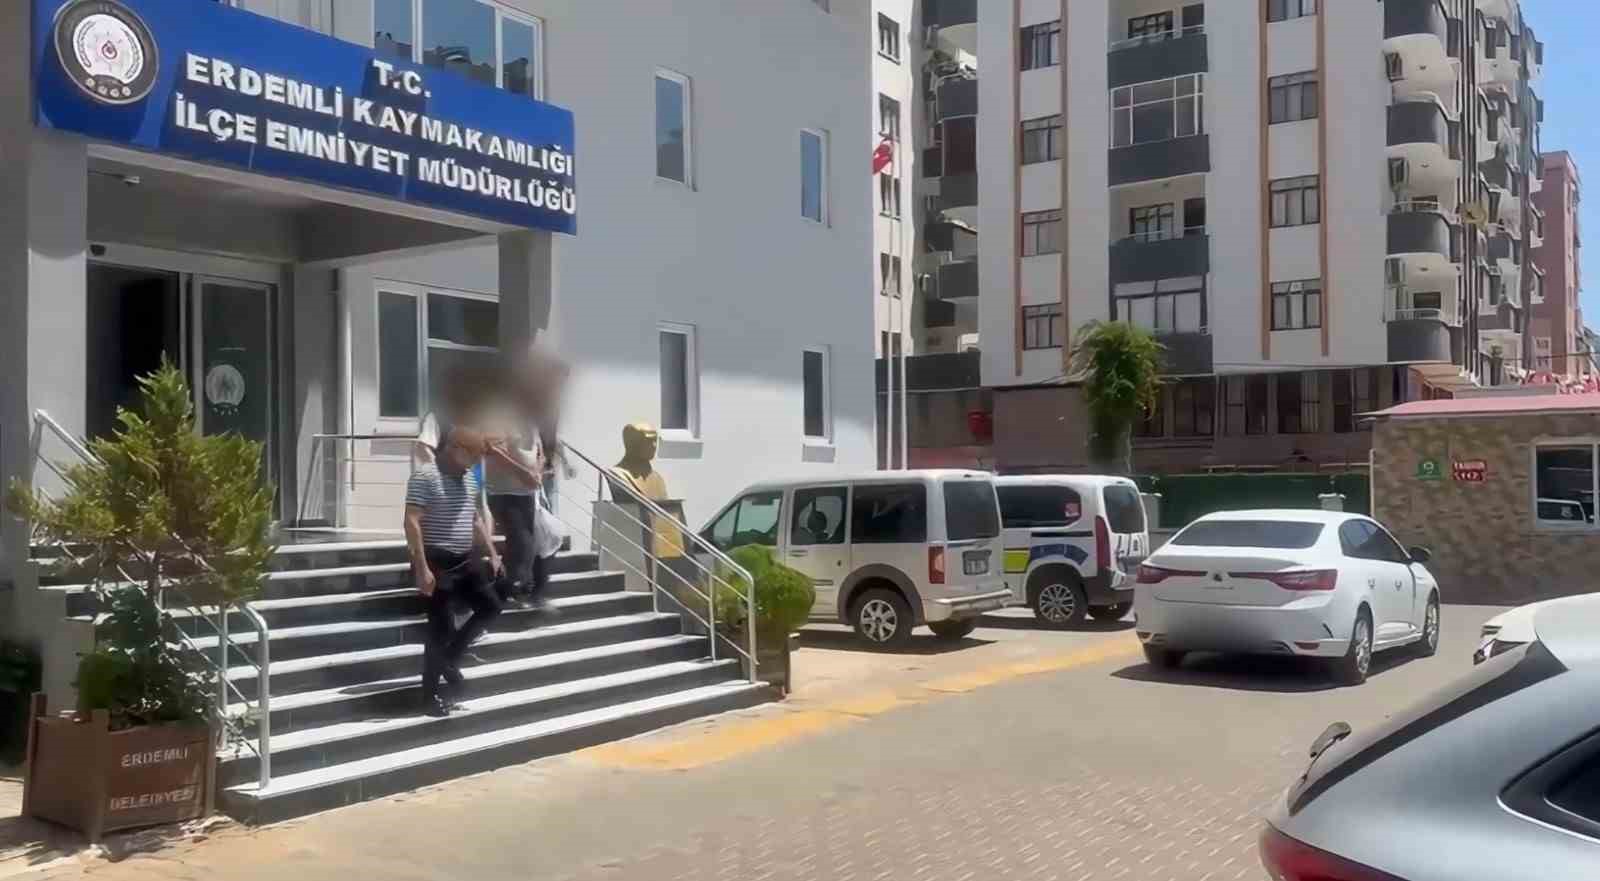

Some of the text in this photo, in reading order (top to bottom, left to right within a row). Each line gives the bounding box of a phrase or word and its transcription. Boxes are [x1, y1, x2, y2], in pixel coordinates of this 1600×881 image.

[186, 53, 573, 176] ERDEMLİ KAYMAKAMLIĞI
[373, 59, 432, 98] T.C.
[175, 92, 577, 215] İLÇE EMNİYET MÜDÜRLÜĞÜ
